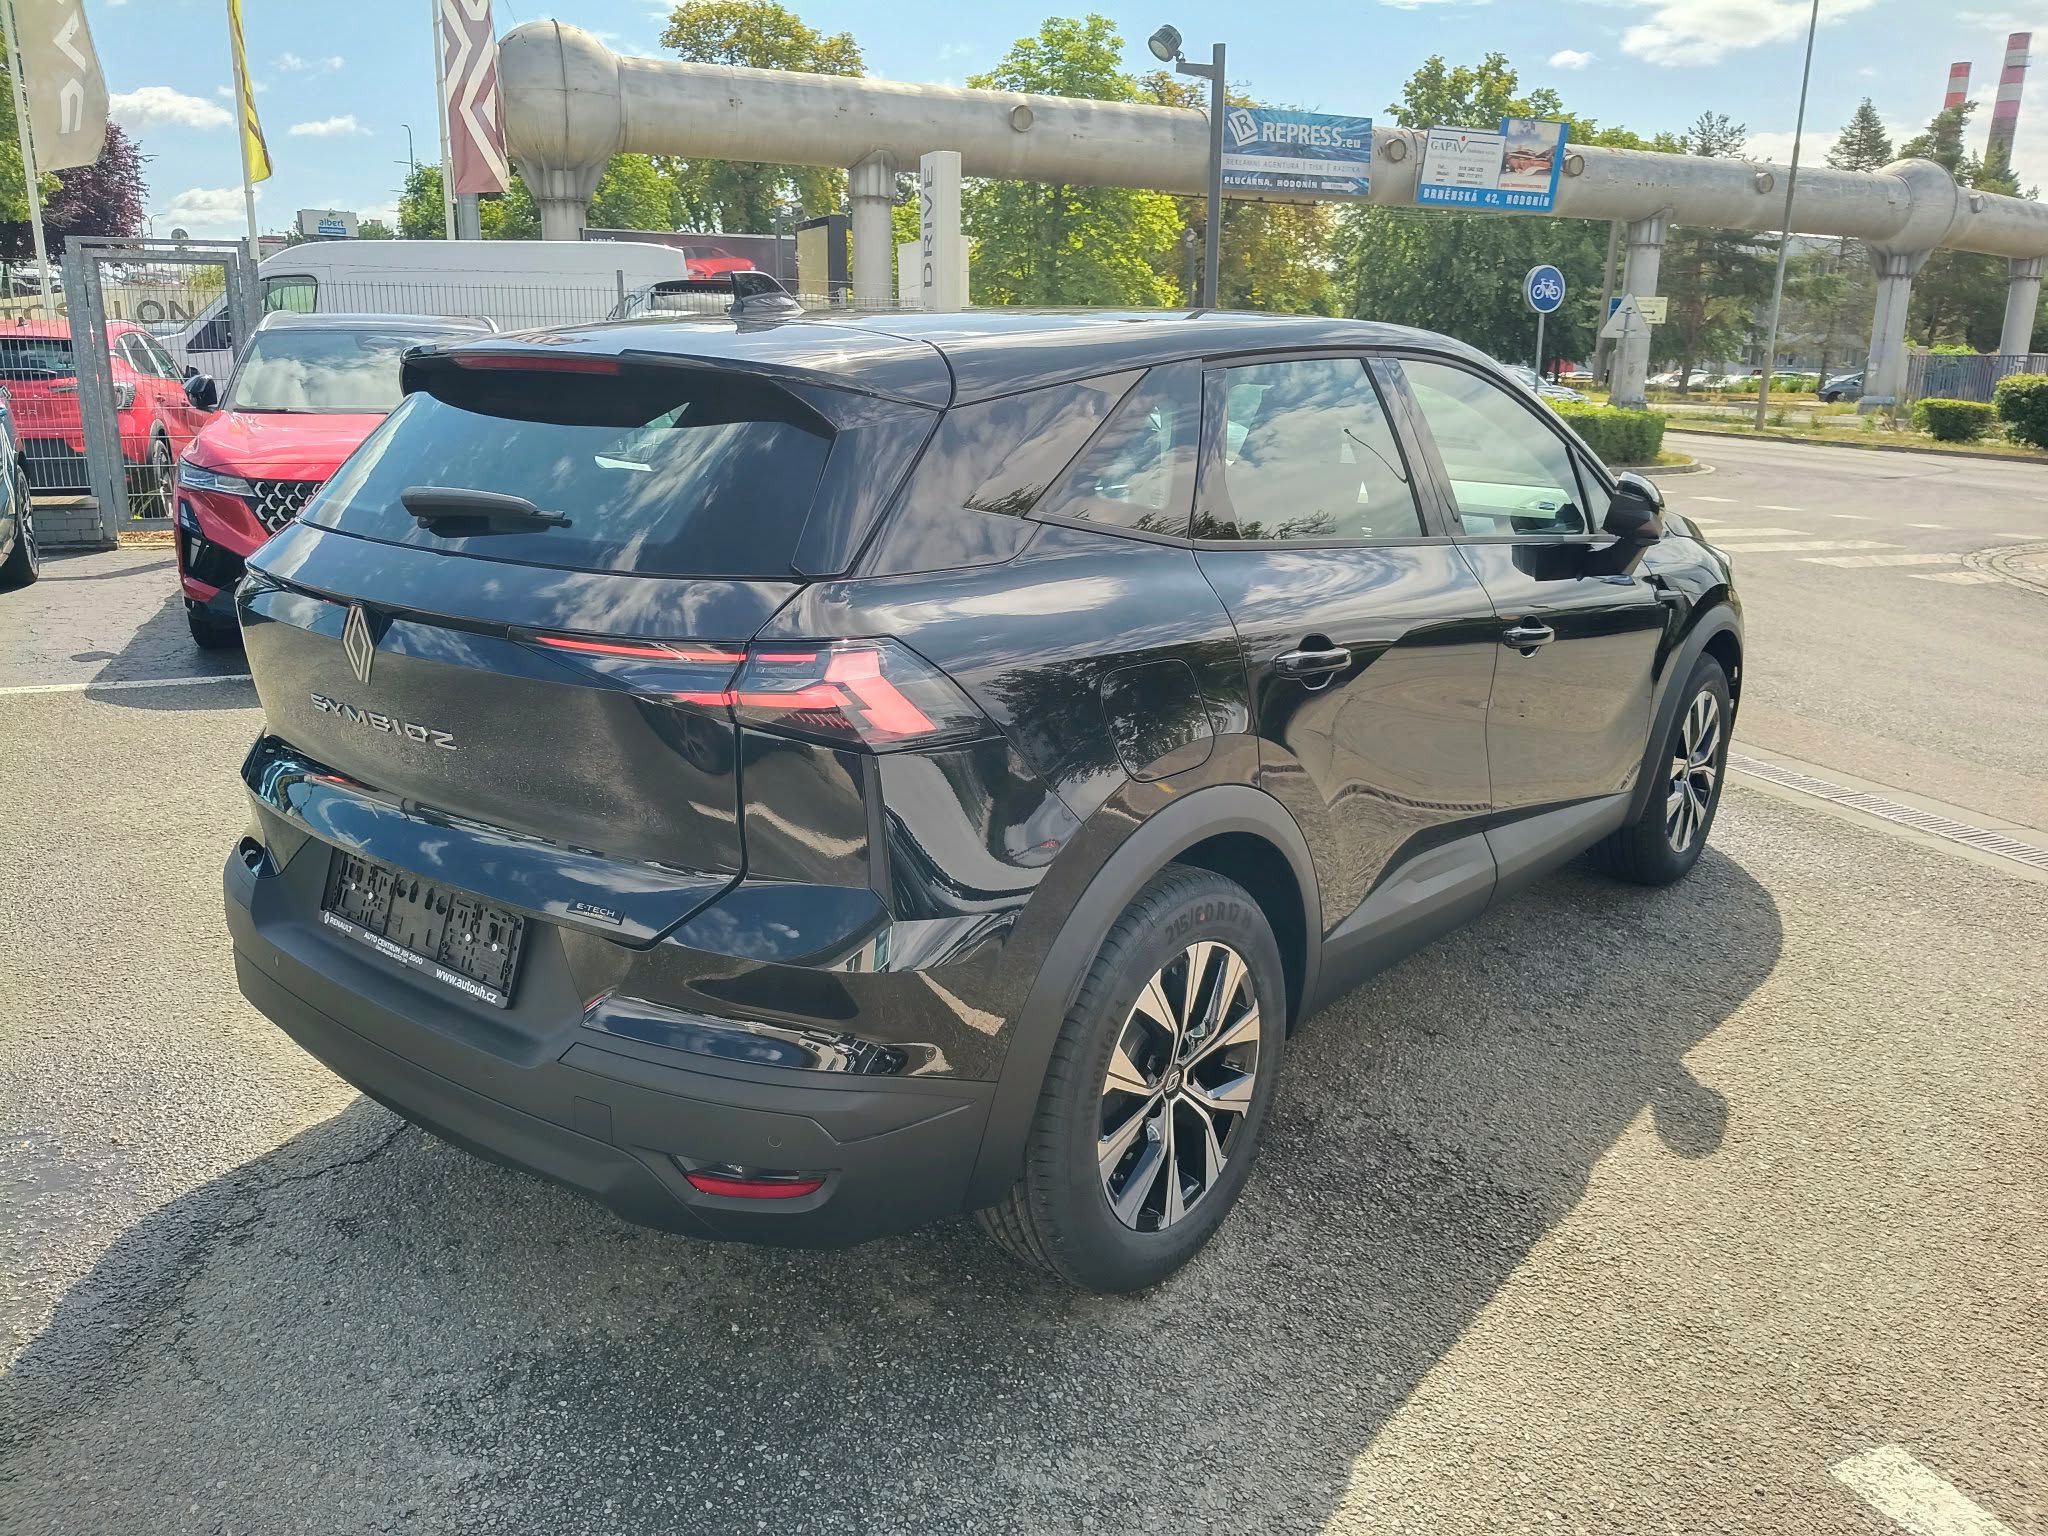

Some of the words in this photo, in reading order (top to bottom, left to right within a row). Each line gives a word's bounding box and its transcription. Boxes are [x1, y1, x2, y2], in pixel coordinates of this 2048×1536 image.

[1276, 178, 1318, 190] HODONÍN
[1506, 194, 1550, 207] HODONÍN
[319, 217, 344, 227] albert
[923, 166, 933, 289] DRIVE
[310, 692, 458, 751] SYMBIOZ
[576, 902, 616, 918] E-TECH
[329, 916, 353, 933] RENAULT
[363, 931, 378, 943] AUTO
[377, 937, 401, 955] CENTRUM
[409, 953, 423, 965] 2000
[436, 968, 498, 1004] www.autouh.cz
